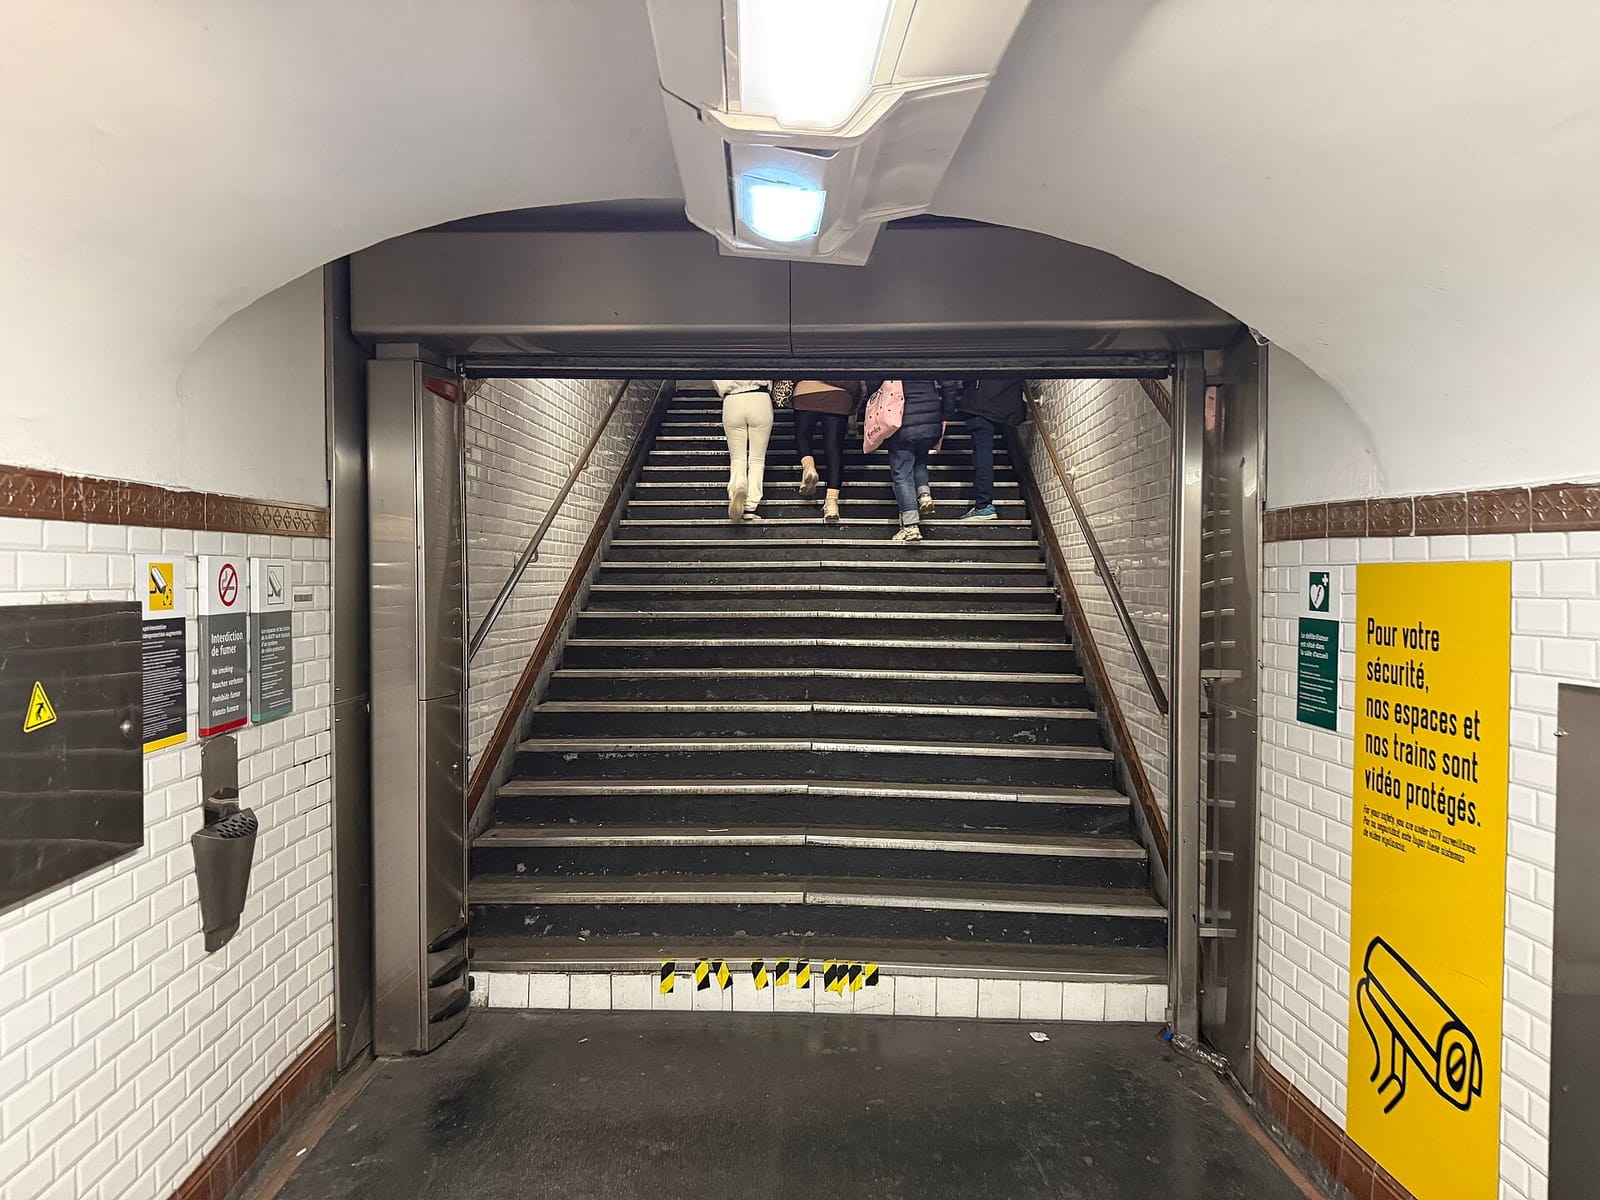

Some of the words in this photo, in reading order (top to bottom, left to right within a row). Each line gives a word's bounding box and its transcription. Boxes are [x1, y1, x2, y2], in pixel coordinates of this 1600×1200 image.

[211, 630, 244, 644] Interdiction
[211, 645, 219, 657] de
[220, 644, 237, 656] fumer
[1367, 617, 1398, 647] Pour
[1402, 621, 1440, 652] votre
[218, 665, 234, 674] smoking
[1366, 656, 1429, 694] sécurité,
[1366, 697, 1390, 721] nos
[1394, 702, 1457, 736] espaces
[1463, 709, 1480, 742] et
[1365, 733, 1388, 758] nos
[1393, 733, 1436, 772] trains
[1442, 751, 1478, 784] sont
[1364, 766, 1401, 800] vidéo
[1406, 781, 1481, 827] protégés.
